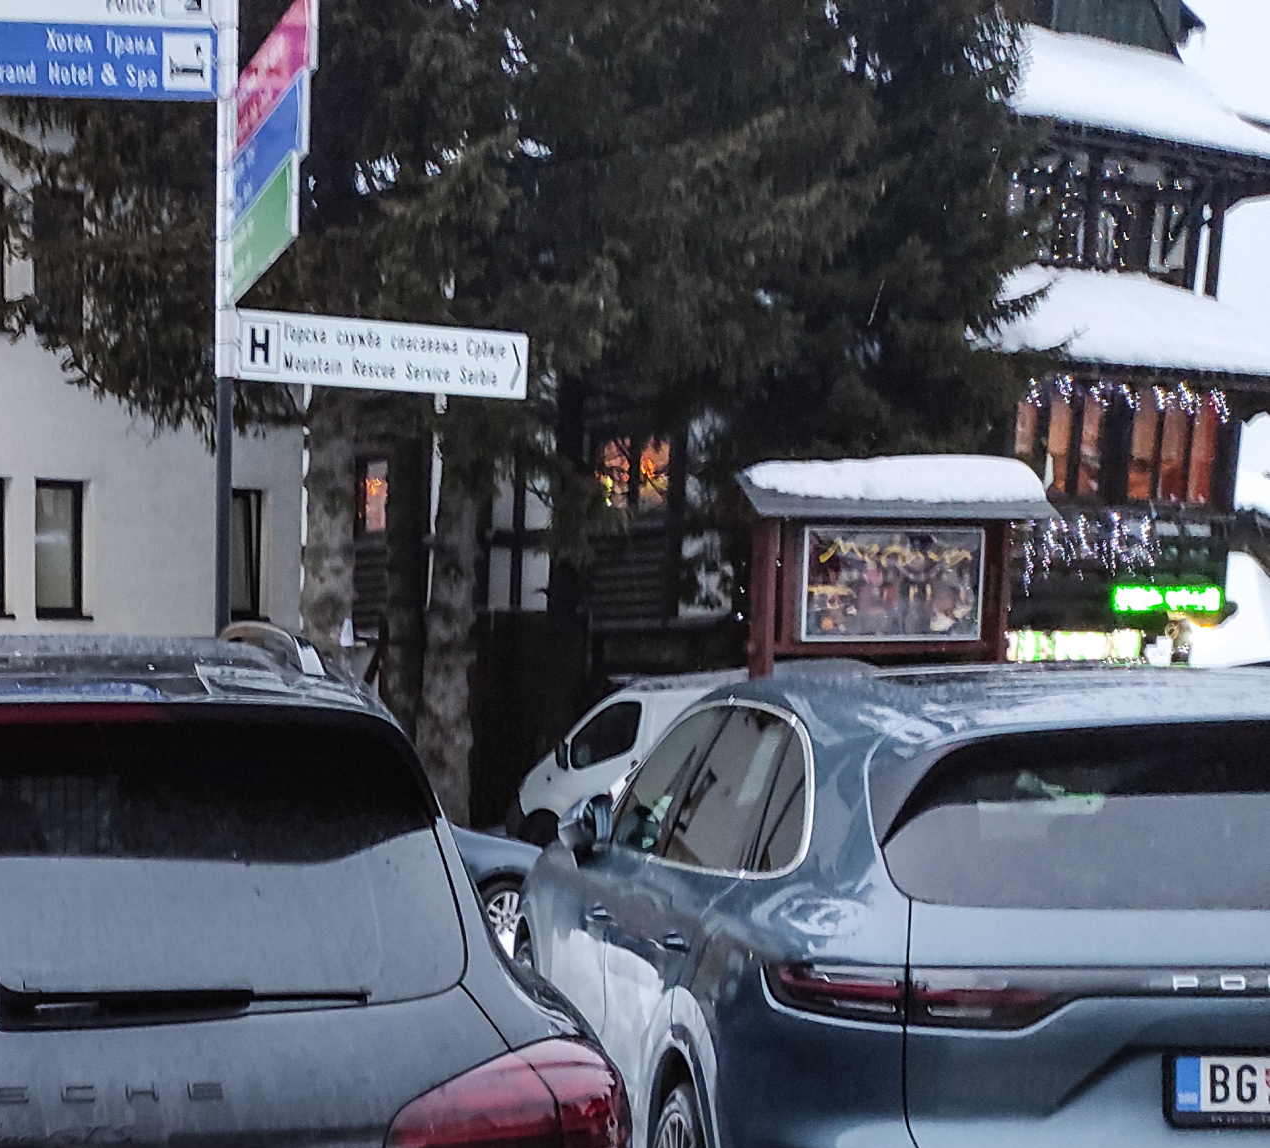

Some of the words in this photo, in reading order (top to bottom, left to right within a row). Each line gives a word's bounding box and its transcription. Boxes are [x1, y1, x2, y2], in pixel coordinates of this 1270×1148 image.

[45, 27, 94, 54] Хотел
[106, 29, 158, 59] Гранд
[48, 60, 94, 87] Hotel
[101, 62, 118, 87] &
[125, 63, 158, 92] Spa
[283, 351, 343, 375] Mountain
[352, 356, 396, 379] Rescue
[405, 361, 451, 383] Service
[460, 365, 498, 386] Serbia
[1209, 1064, 1258, 1104] BG
